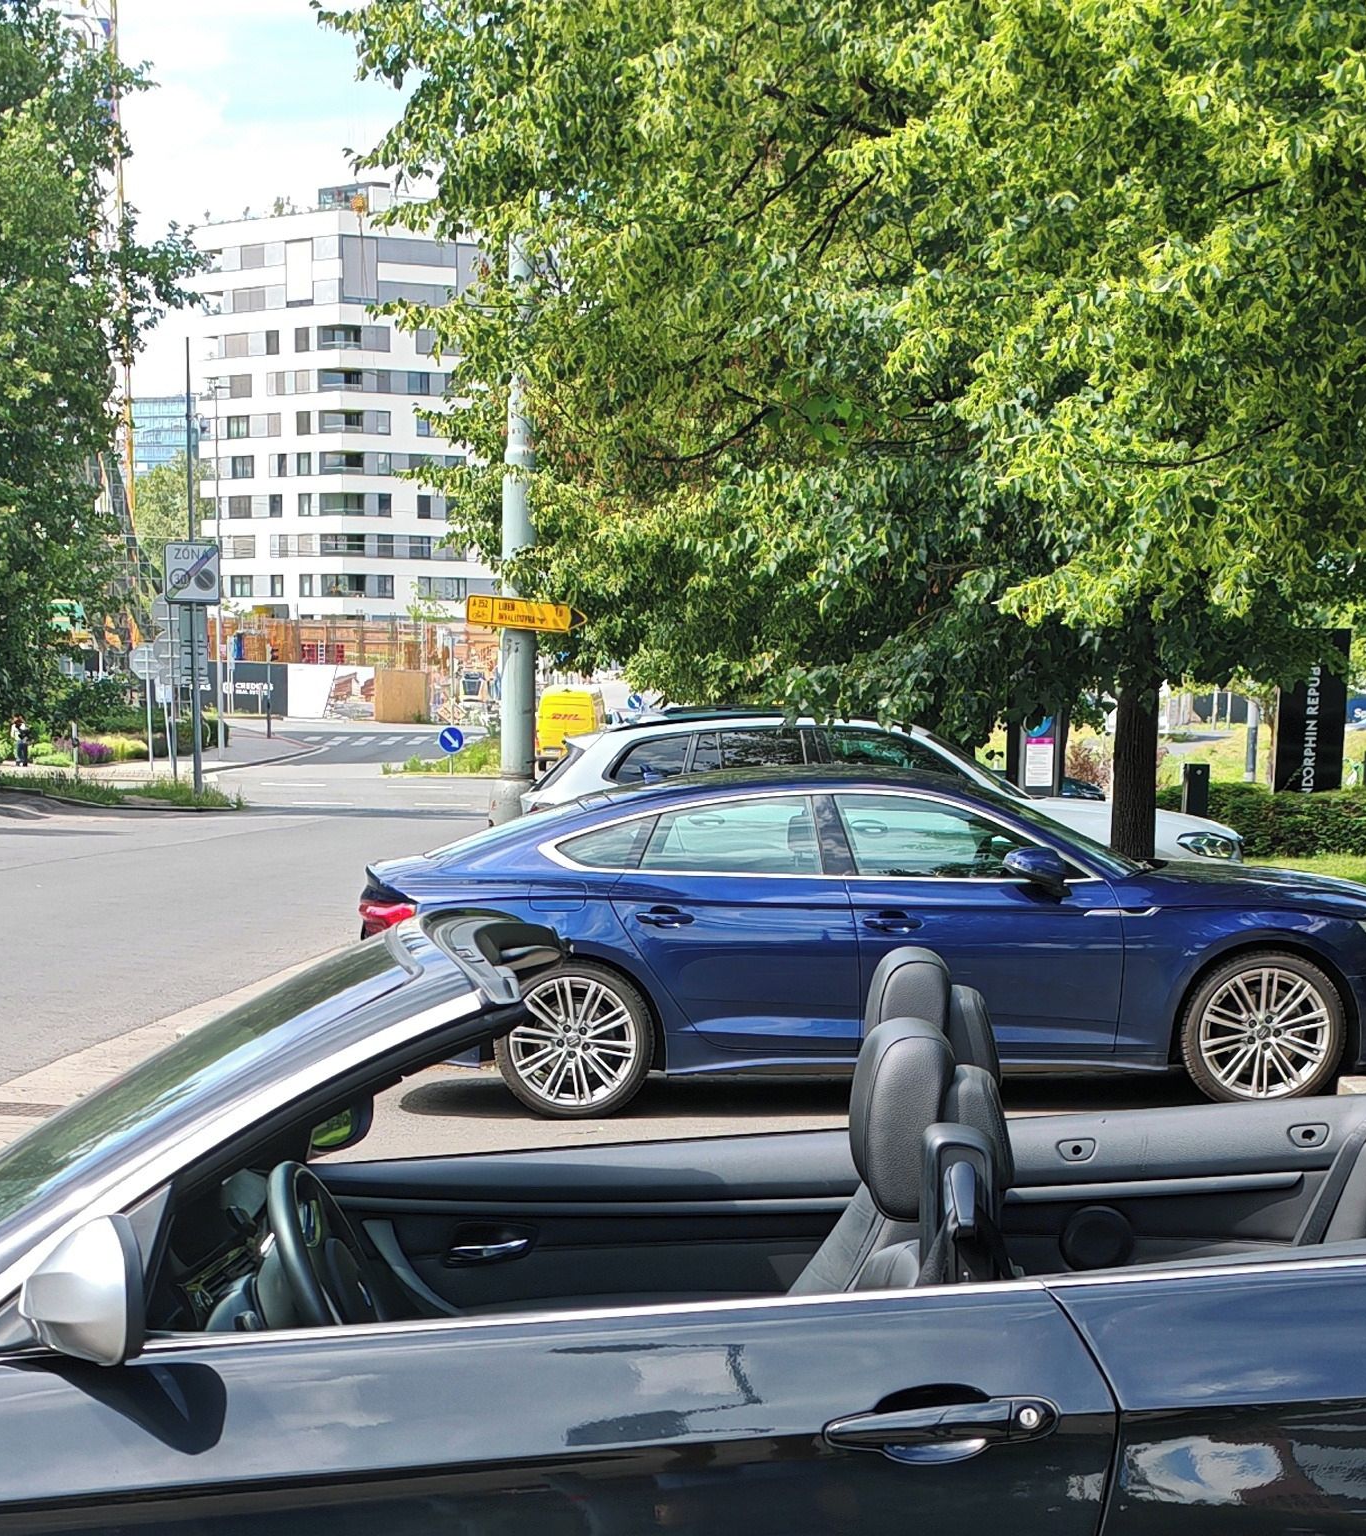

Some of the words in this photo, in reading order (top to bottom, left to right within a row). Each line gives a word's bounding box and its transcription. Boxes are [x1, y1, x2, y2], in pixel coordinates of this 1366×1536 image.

[174, 545, 209, 560] ZÓNA
[173, 573, 189, 585] 30
[1301, 720, 1318, 794] NDORPHIN
